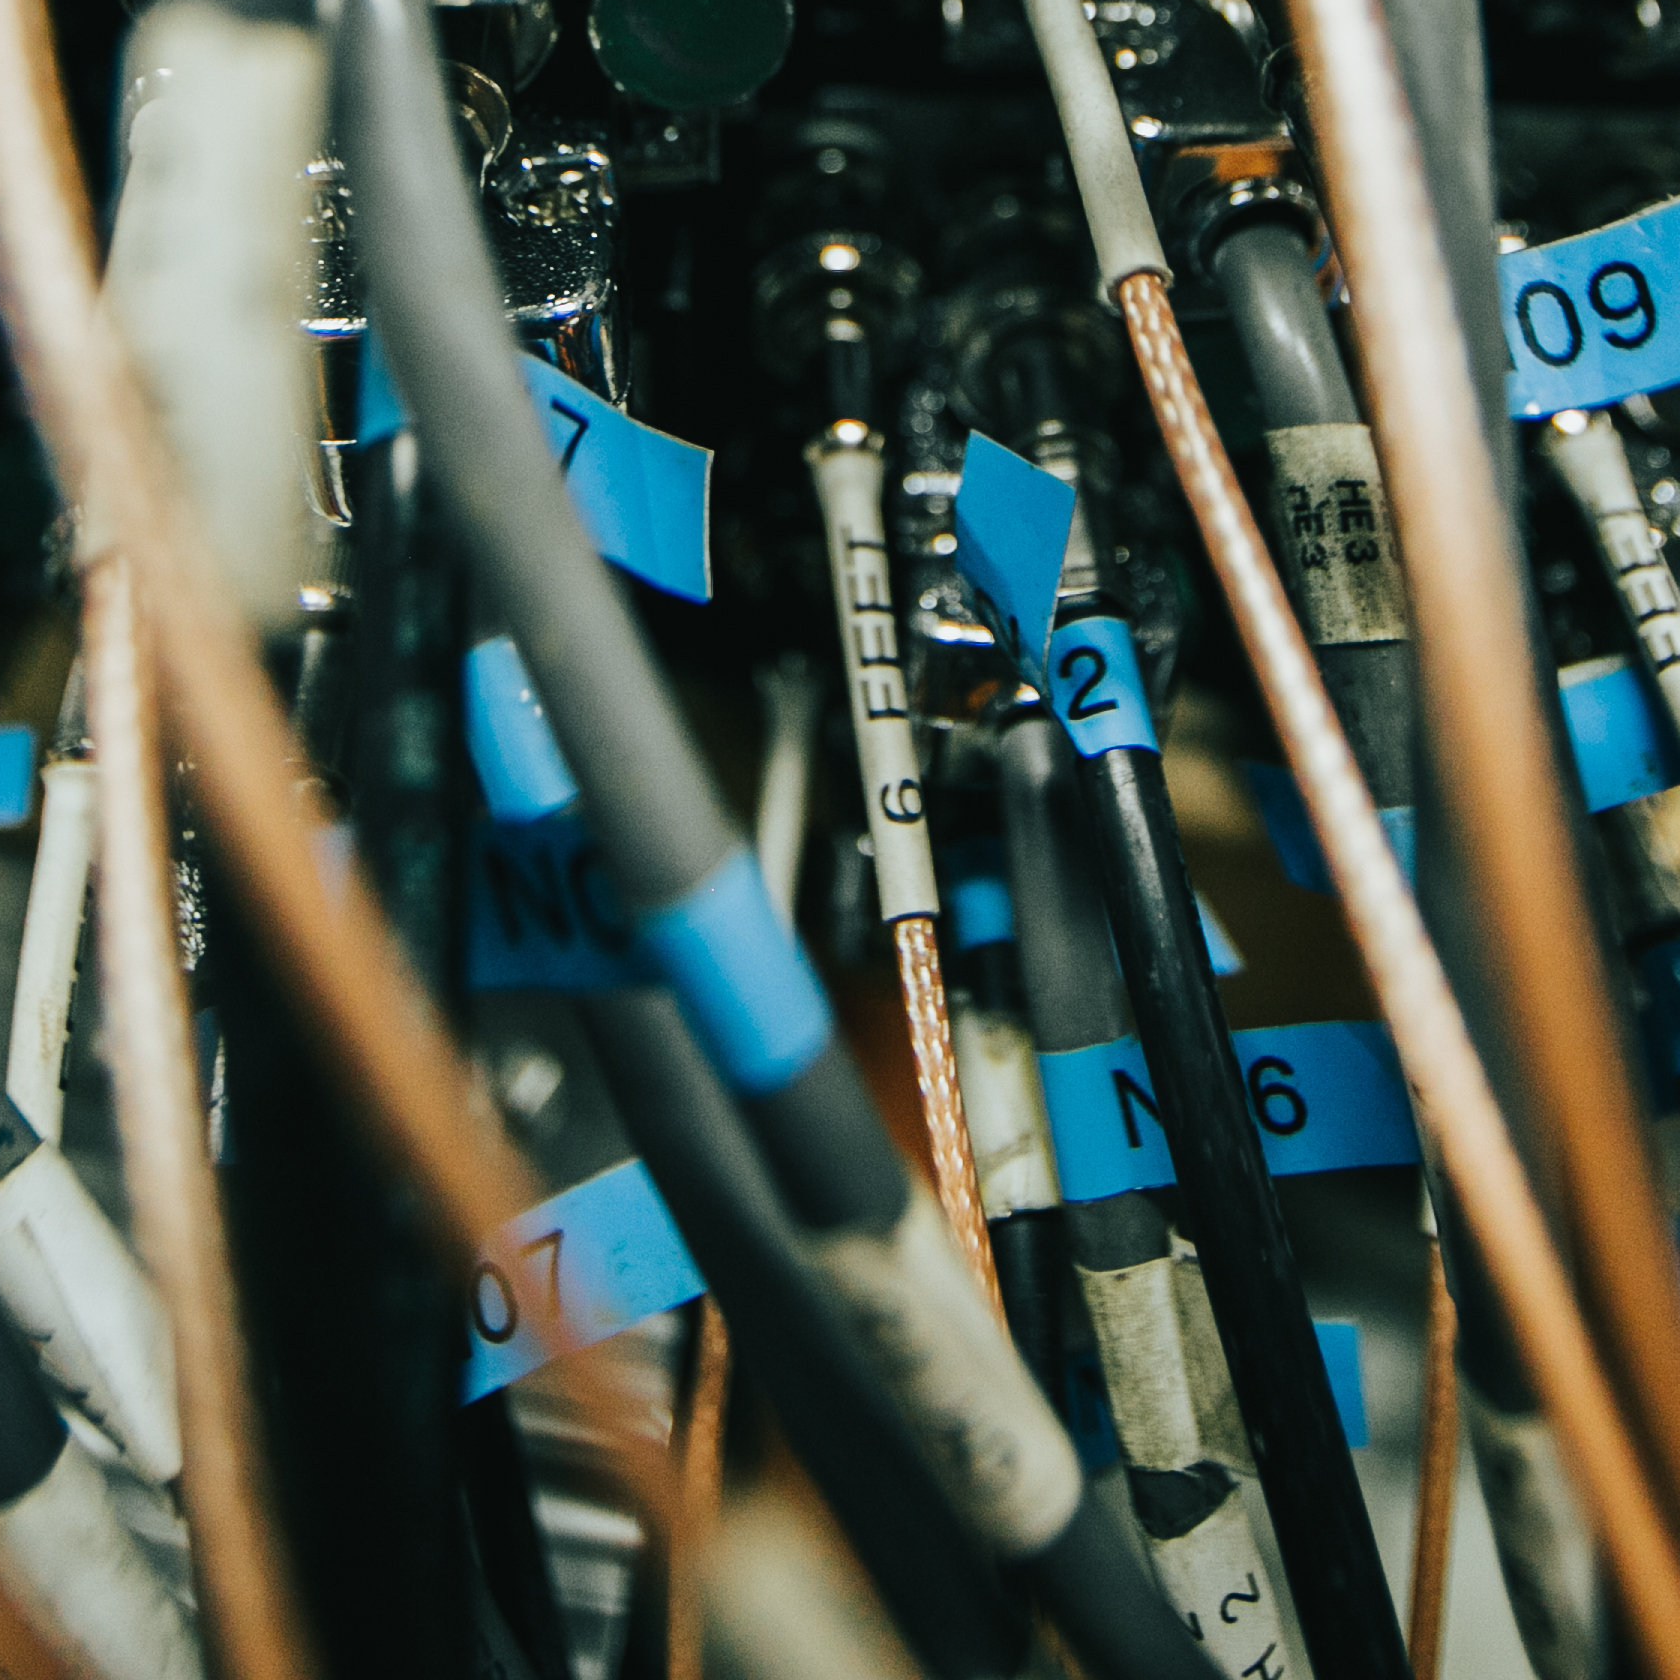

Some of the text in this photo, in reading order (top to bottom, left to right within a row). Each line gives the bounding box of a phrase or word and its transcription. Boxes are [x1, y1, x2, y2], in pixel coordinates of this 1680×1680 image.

[1510, 260, 1657, 368] 09
[1334, 478, 1381, 566] HE3
[1110, 1055, 1310, 1150] N6
[462, 1230, 563, 1346] 07
